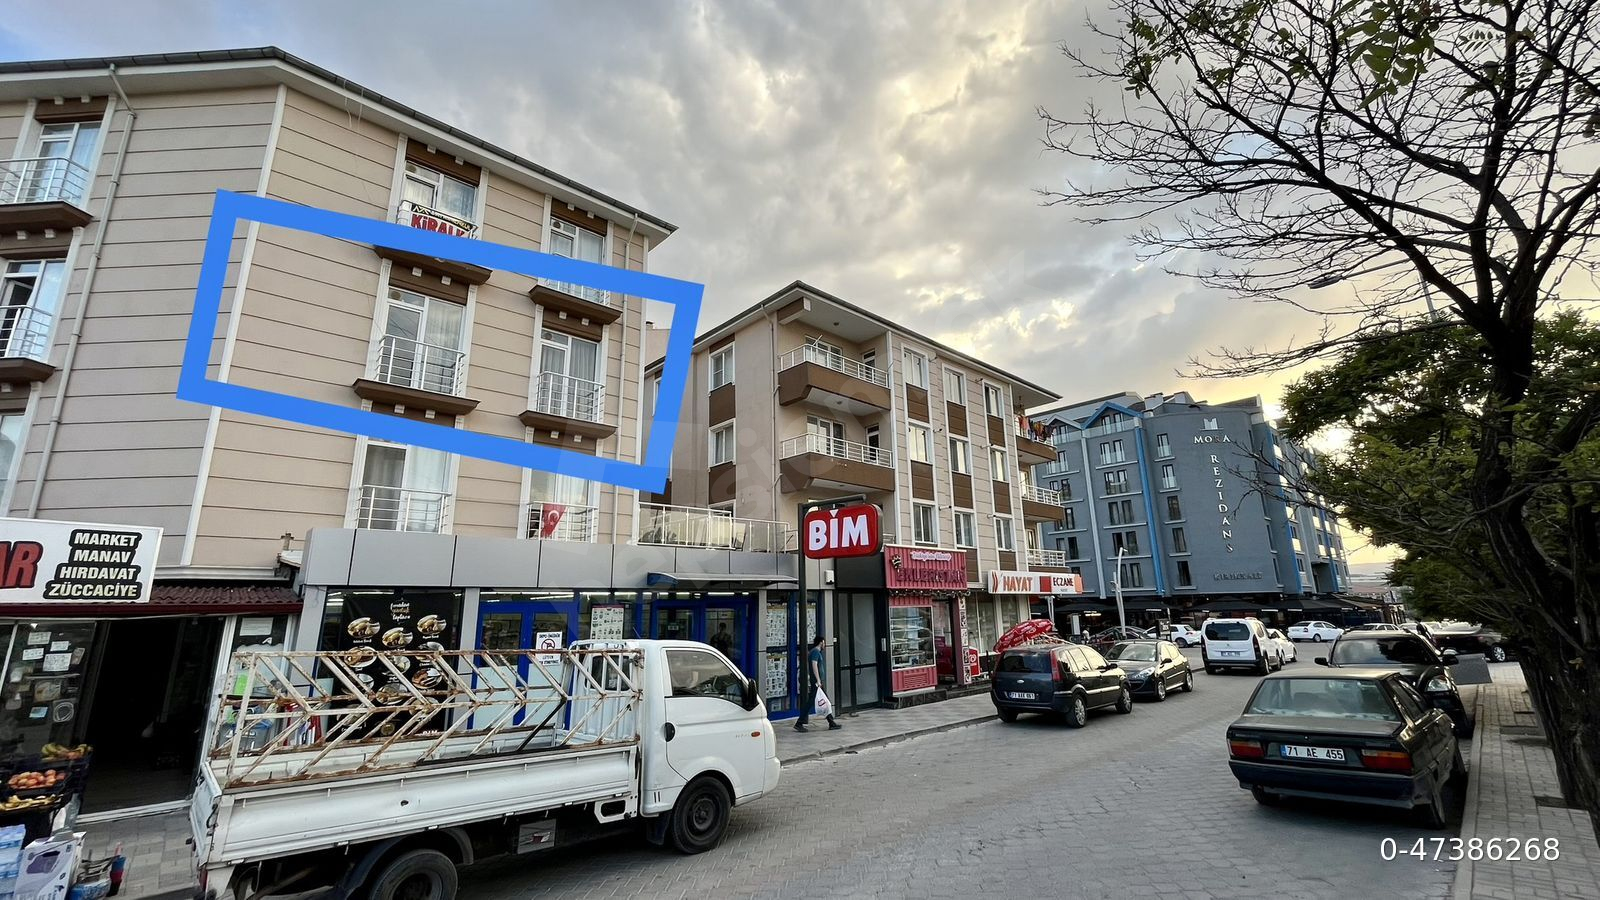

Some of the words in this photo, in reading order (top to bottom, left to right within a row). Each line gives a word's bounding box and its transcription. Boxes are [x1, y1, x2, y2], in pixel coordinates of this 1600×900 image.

[808, 509, 870, 551] BİM
[74, 532, 138, 546] MARKET
[73, 550, 131, 563] MANAV
[59, 566, 137, 580] HIRDAVAT
[1003, 575, 1033, 592] HAYAT
[1053, 577, 1074, 587] ECZANE
[48, 582, 138, 597] ZÜCCACİYE
[1287, 746, 1299, 757] 71
[1306, 747, 1319, 758] AE
[1325, 749, 1344, 760] 455
